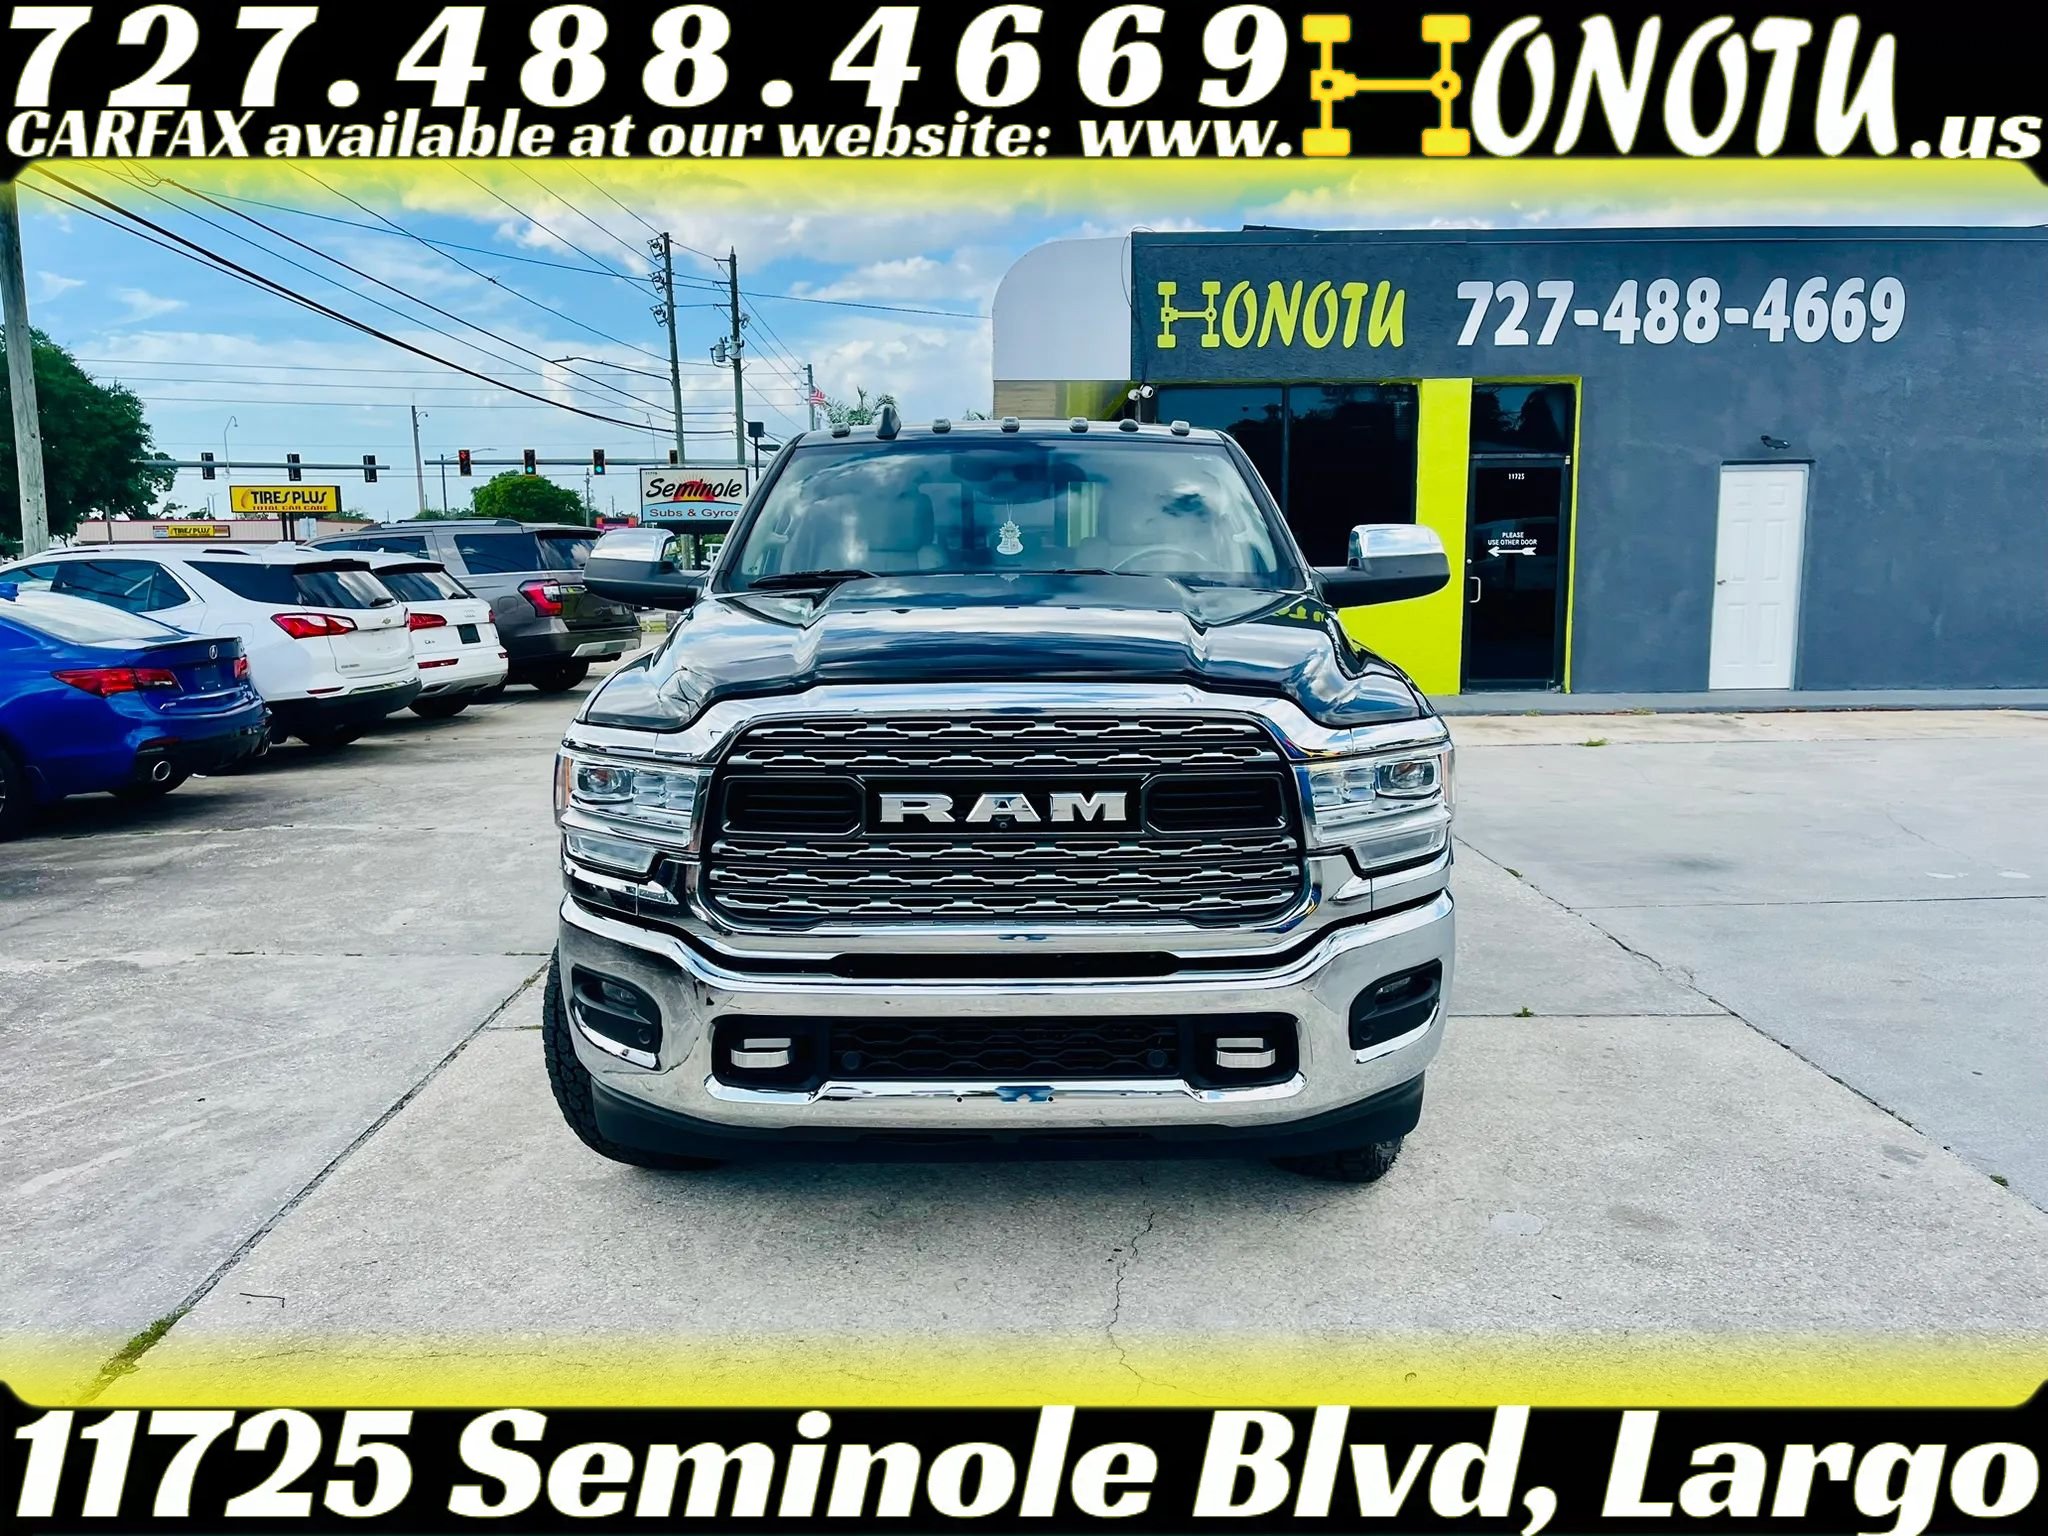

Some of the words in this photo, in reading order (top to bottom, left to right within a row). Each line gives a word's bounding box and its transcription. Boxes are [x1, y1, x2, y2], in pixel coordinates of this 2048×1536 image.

[1456, 276, 1907, 346] 727-488-4669
[251, 490, 291, 505] TIRES
[291, 489, 328, 504] PLUS
[645, 477, 743, 498] Seminole
[649, 508, 683, 517] Subs
[687, 508, 697, 517] &
[701, 508, 740, 519] Gyros
[879, 791, 1128, 823] RAM
